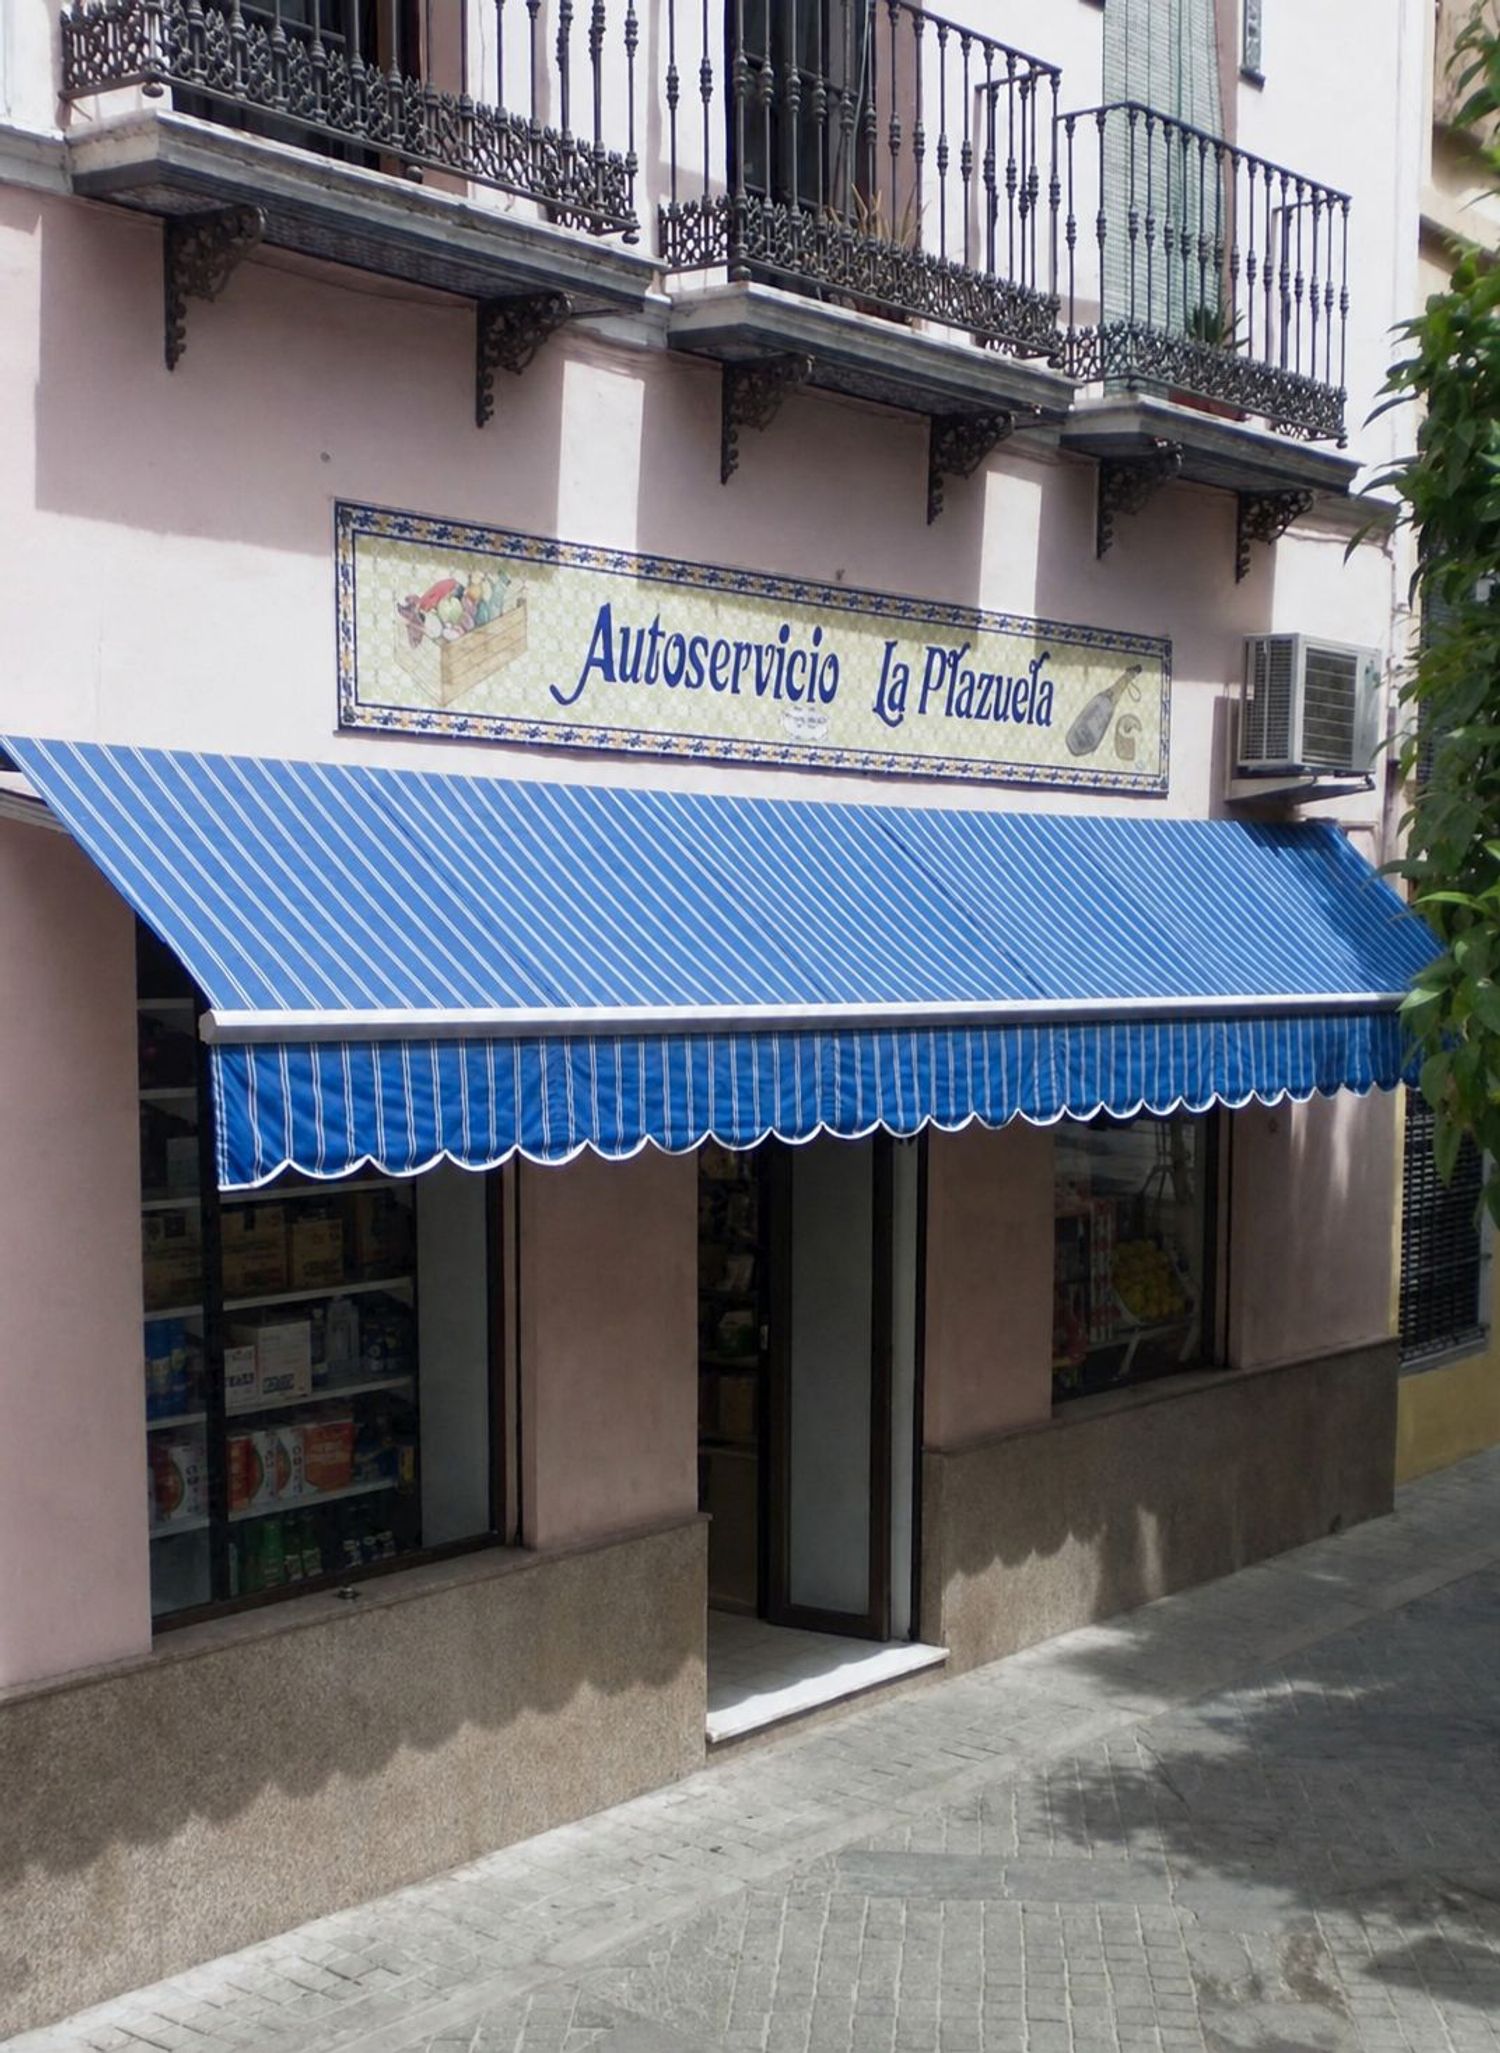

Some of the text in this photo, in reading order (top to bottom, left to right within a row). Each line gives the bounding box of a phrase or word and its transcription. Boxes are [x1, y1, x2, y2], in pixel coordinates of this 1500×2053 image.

[550, 602, 1054, 728] Autoservicio La Plazuela
